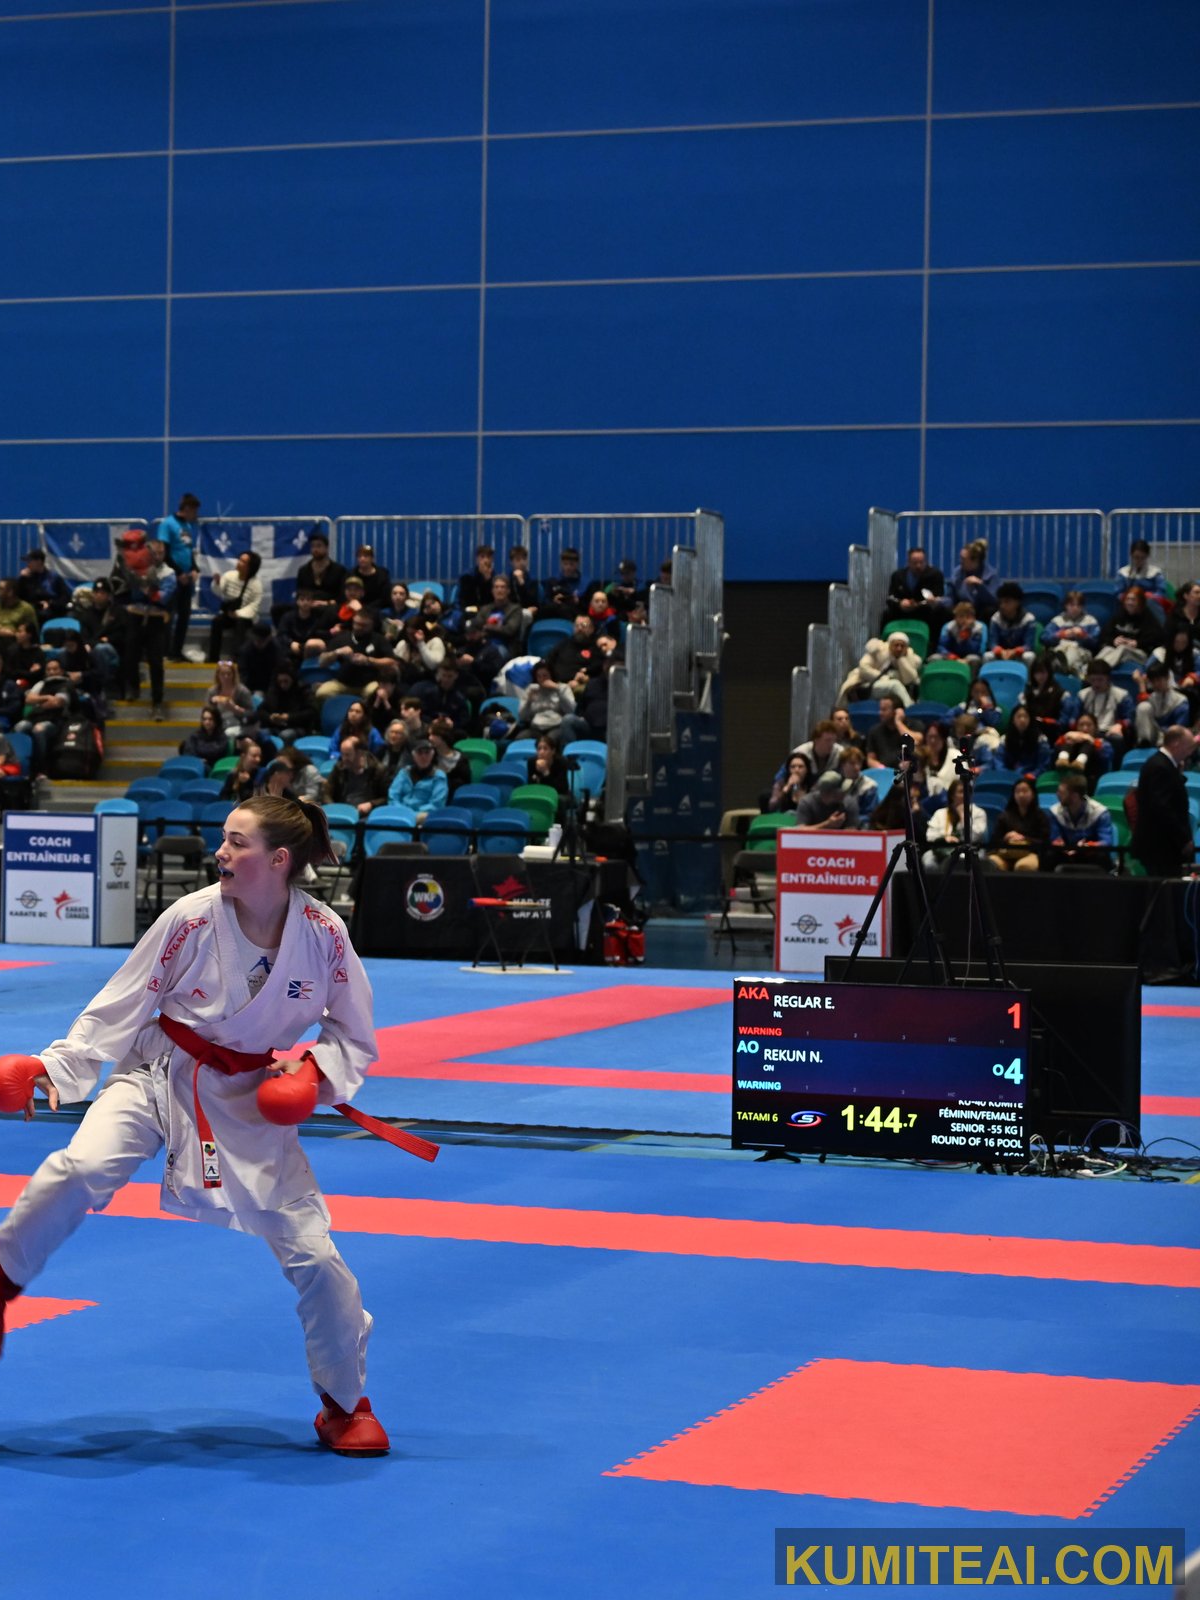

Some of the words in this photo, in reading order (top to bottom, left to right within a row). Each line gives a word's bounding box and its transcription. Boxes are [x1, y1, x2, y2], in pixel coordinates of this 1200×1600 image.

[29, 836, 72, 848] COACH
[807, 856, 856, 868] COACH
[784, 936, 816, 944] KARATE
[737, 986, 769, 1000] AKA
[774, 995, 821, 1009] REGLAR
[824, 997, 835, 1010] E.
[1007, 1002, 1021, 1029] 1
[738, 1026, 782, 1036] WARNING
[736, 1040, 760, 1054] AO
[763, 1049, 806, 1063] REKUN
[809, 1051, 823, 1063] N.
[763, 1064, 775, 1072] ON
[737, 1080, 782, 1091] WARNING
[736, 1111, 771, 1121] TATAMI
[772, 1112, 779, 1122] 6
[841, 1104, 918, 1133] 1:44.7
[938, 1107, 1017, 1122] FÉMININ/FEMALE
[950, 1122, 985, 1133] SENIOR
[986, 1124, 1003, 1134] -55
[1004, 1125, 1018, 1135] KG
[931, 1134, 967, 1146] ROUND
[968, 1136, 981, 1146] OF
[984, 1137, 995, 1147] 16
[996, 1138, 1023, 1149] POOL
